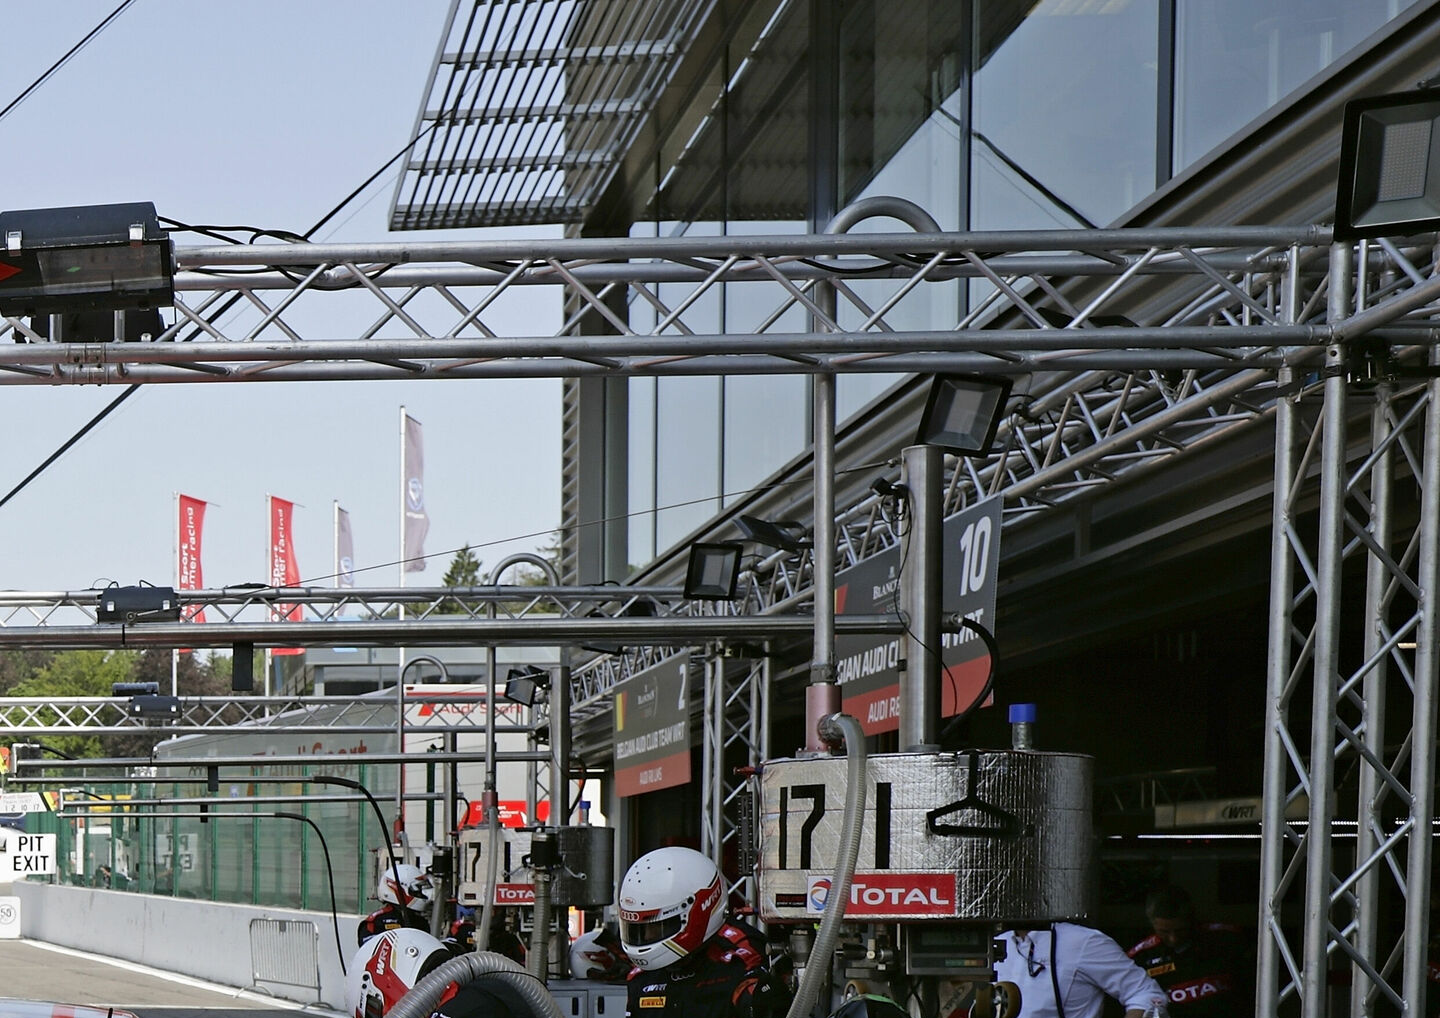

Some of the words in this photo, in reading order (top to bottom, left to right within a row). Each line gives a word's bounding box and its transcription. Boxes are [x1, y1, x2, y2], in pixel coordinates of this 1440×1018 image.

[960, 516, 992, 597] 10
[862, 645, 887, 678] AUDI
[678, 664, 686, 710] 2
[867, 699, 888, 724] AUDI
[779, 784, 826, 870] 17
[875, 782, 892, 870] 1
[18, 836, 44, 852] PIT
[13, 856, 49, 871] EXIT
[464, 842, 481, 882] 17
[498, 888, 535, 899] TOTA
[701, 886, 722, 912] WRT
[850, 884, 950, 905] TOTAL
[376, 944, 390, 975] WRT
